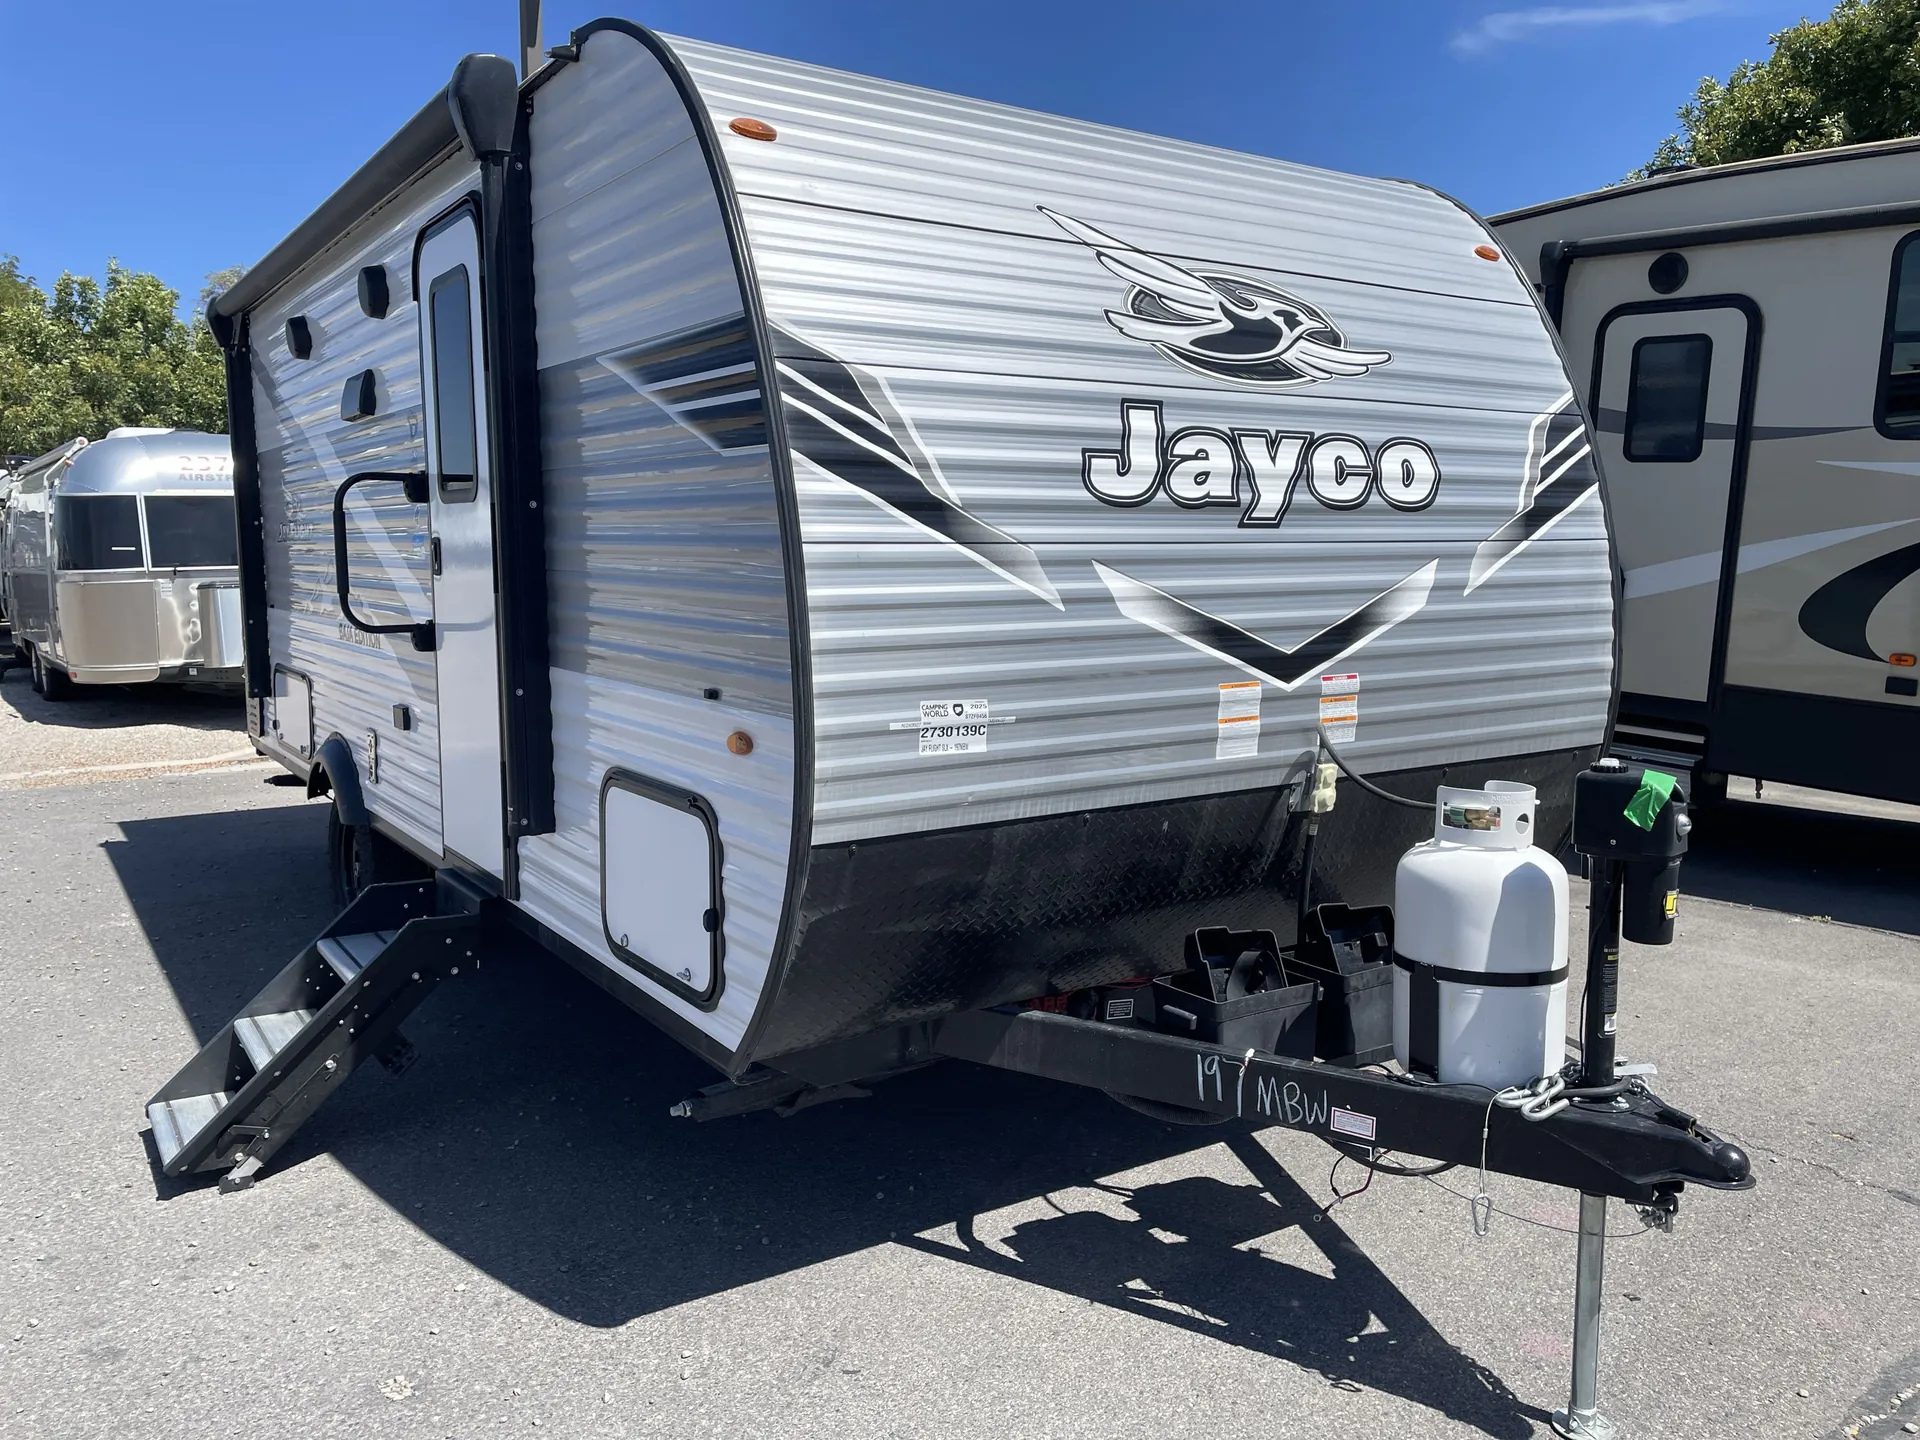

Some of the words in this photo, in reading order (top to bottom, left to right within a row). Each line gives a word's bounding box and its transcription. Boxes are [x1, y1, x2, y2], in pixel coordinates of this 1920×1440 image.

[1081, 398, 1442, 528] Jayco
[920, 725, 986, 738] 2730139C
[1256, 1075, 1328, 1126] MBW
